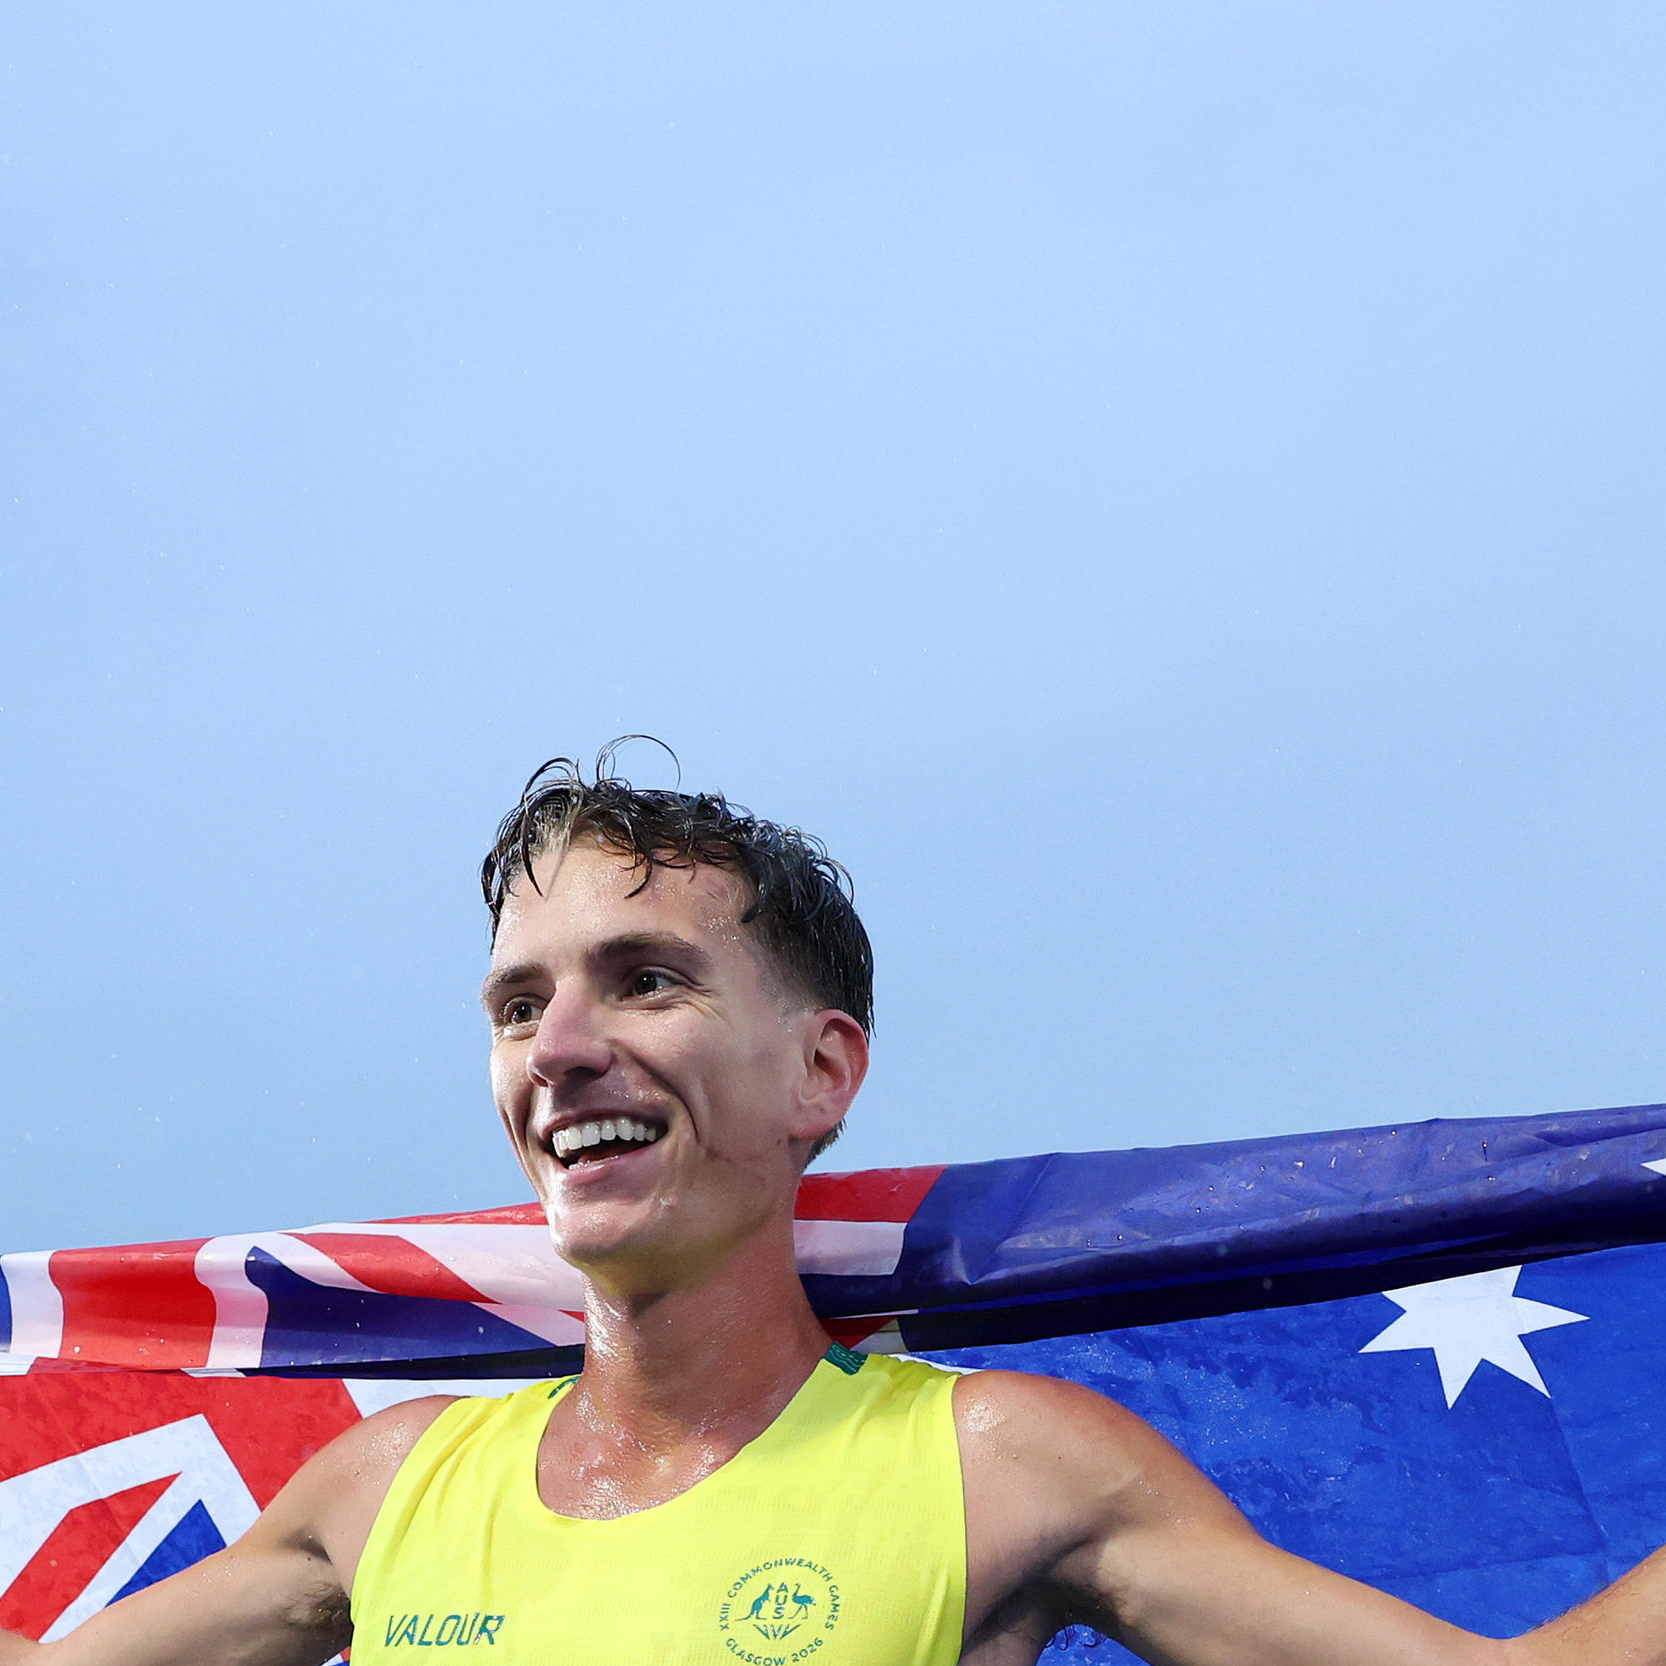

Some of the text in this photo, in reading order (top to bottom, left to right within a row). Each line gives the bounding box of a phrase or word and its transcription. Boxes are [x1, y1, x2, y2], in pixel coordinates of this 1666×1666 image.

[719, 1558, 841, 1631] XXIII COMMONWEALTH GAMES
[384, 1612, 506, 1648] VALOUR
[725, 1637, 824, 1666] GLASGOW 2026
